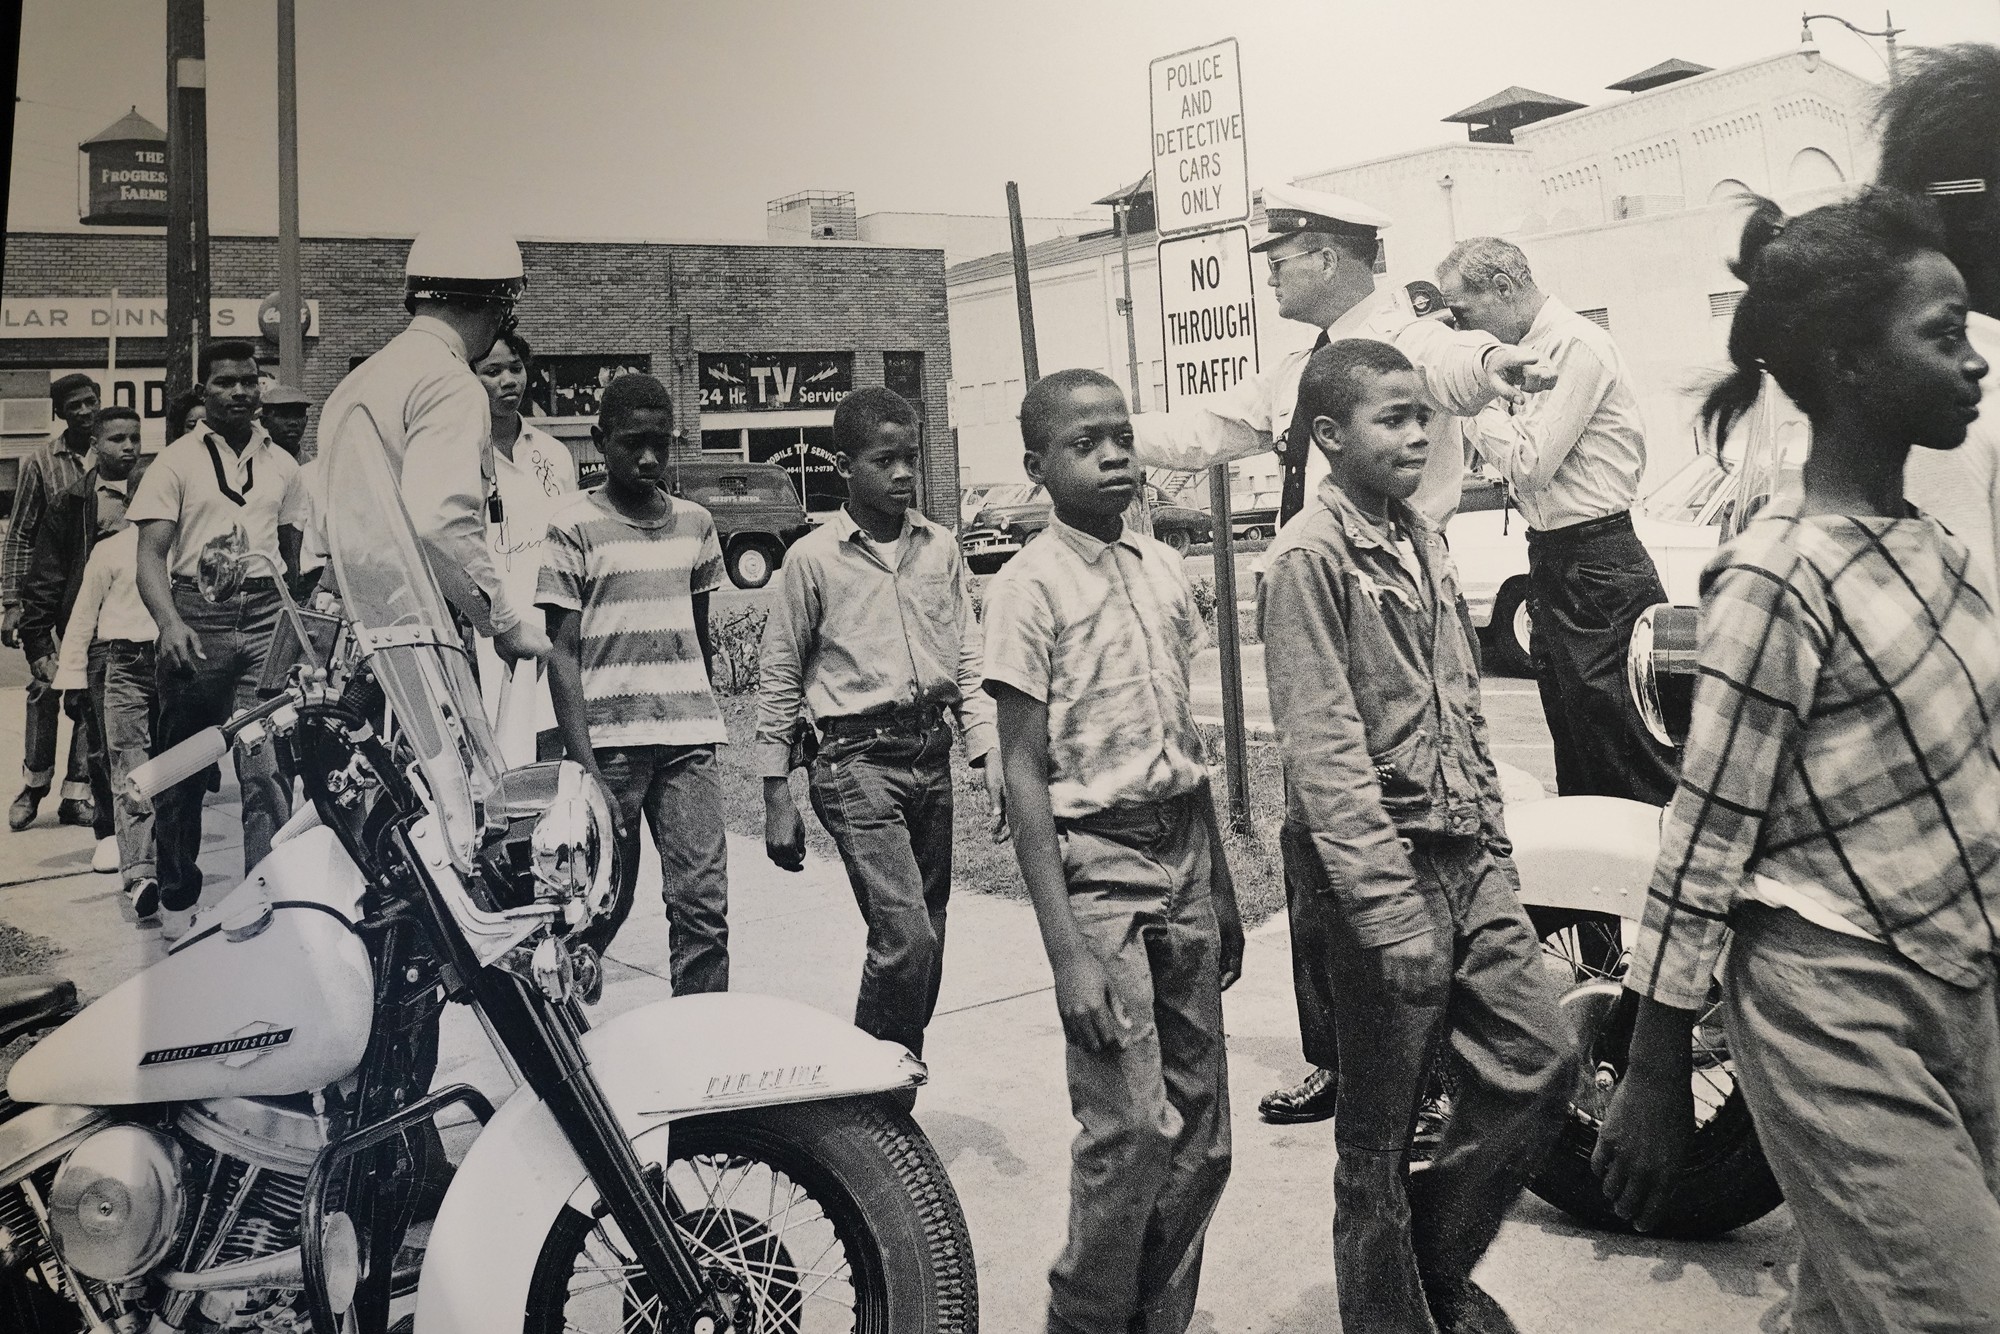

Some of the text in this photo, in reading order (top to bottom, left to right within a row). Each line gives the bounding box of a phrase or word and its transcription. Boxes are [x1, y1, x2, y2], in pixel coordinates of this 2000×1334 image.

[1167, 54, 1223, 91] POLICE
[1181, 89, 1212, 119] AND
[1156, 114, 1242, 157] DETECTIVE
[135, 151, 165, 164] THE
[1179, 152, 1221, 183] CARS
[102, 168, 168, 184] PROGRES
[120, 185, 168, 201] FARME
[1181, 184, 1222, 215] ONLY
[1190, 255, 1220, 292] NO
[4, 308, 236, 328] LAR DINNS
[1168, 302, 1251, 346] THROUGH
[700, 366, 851, 406] 24 Hr. TV Service
[794, 443, 809, 455] TV
[581, 463, 607, 476] HAN
